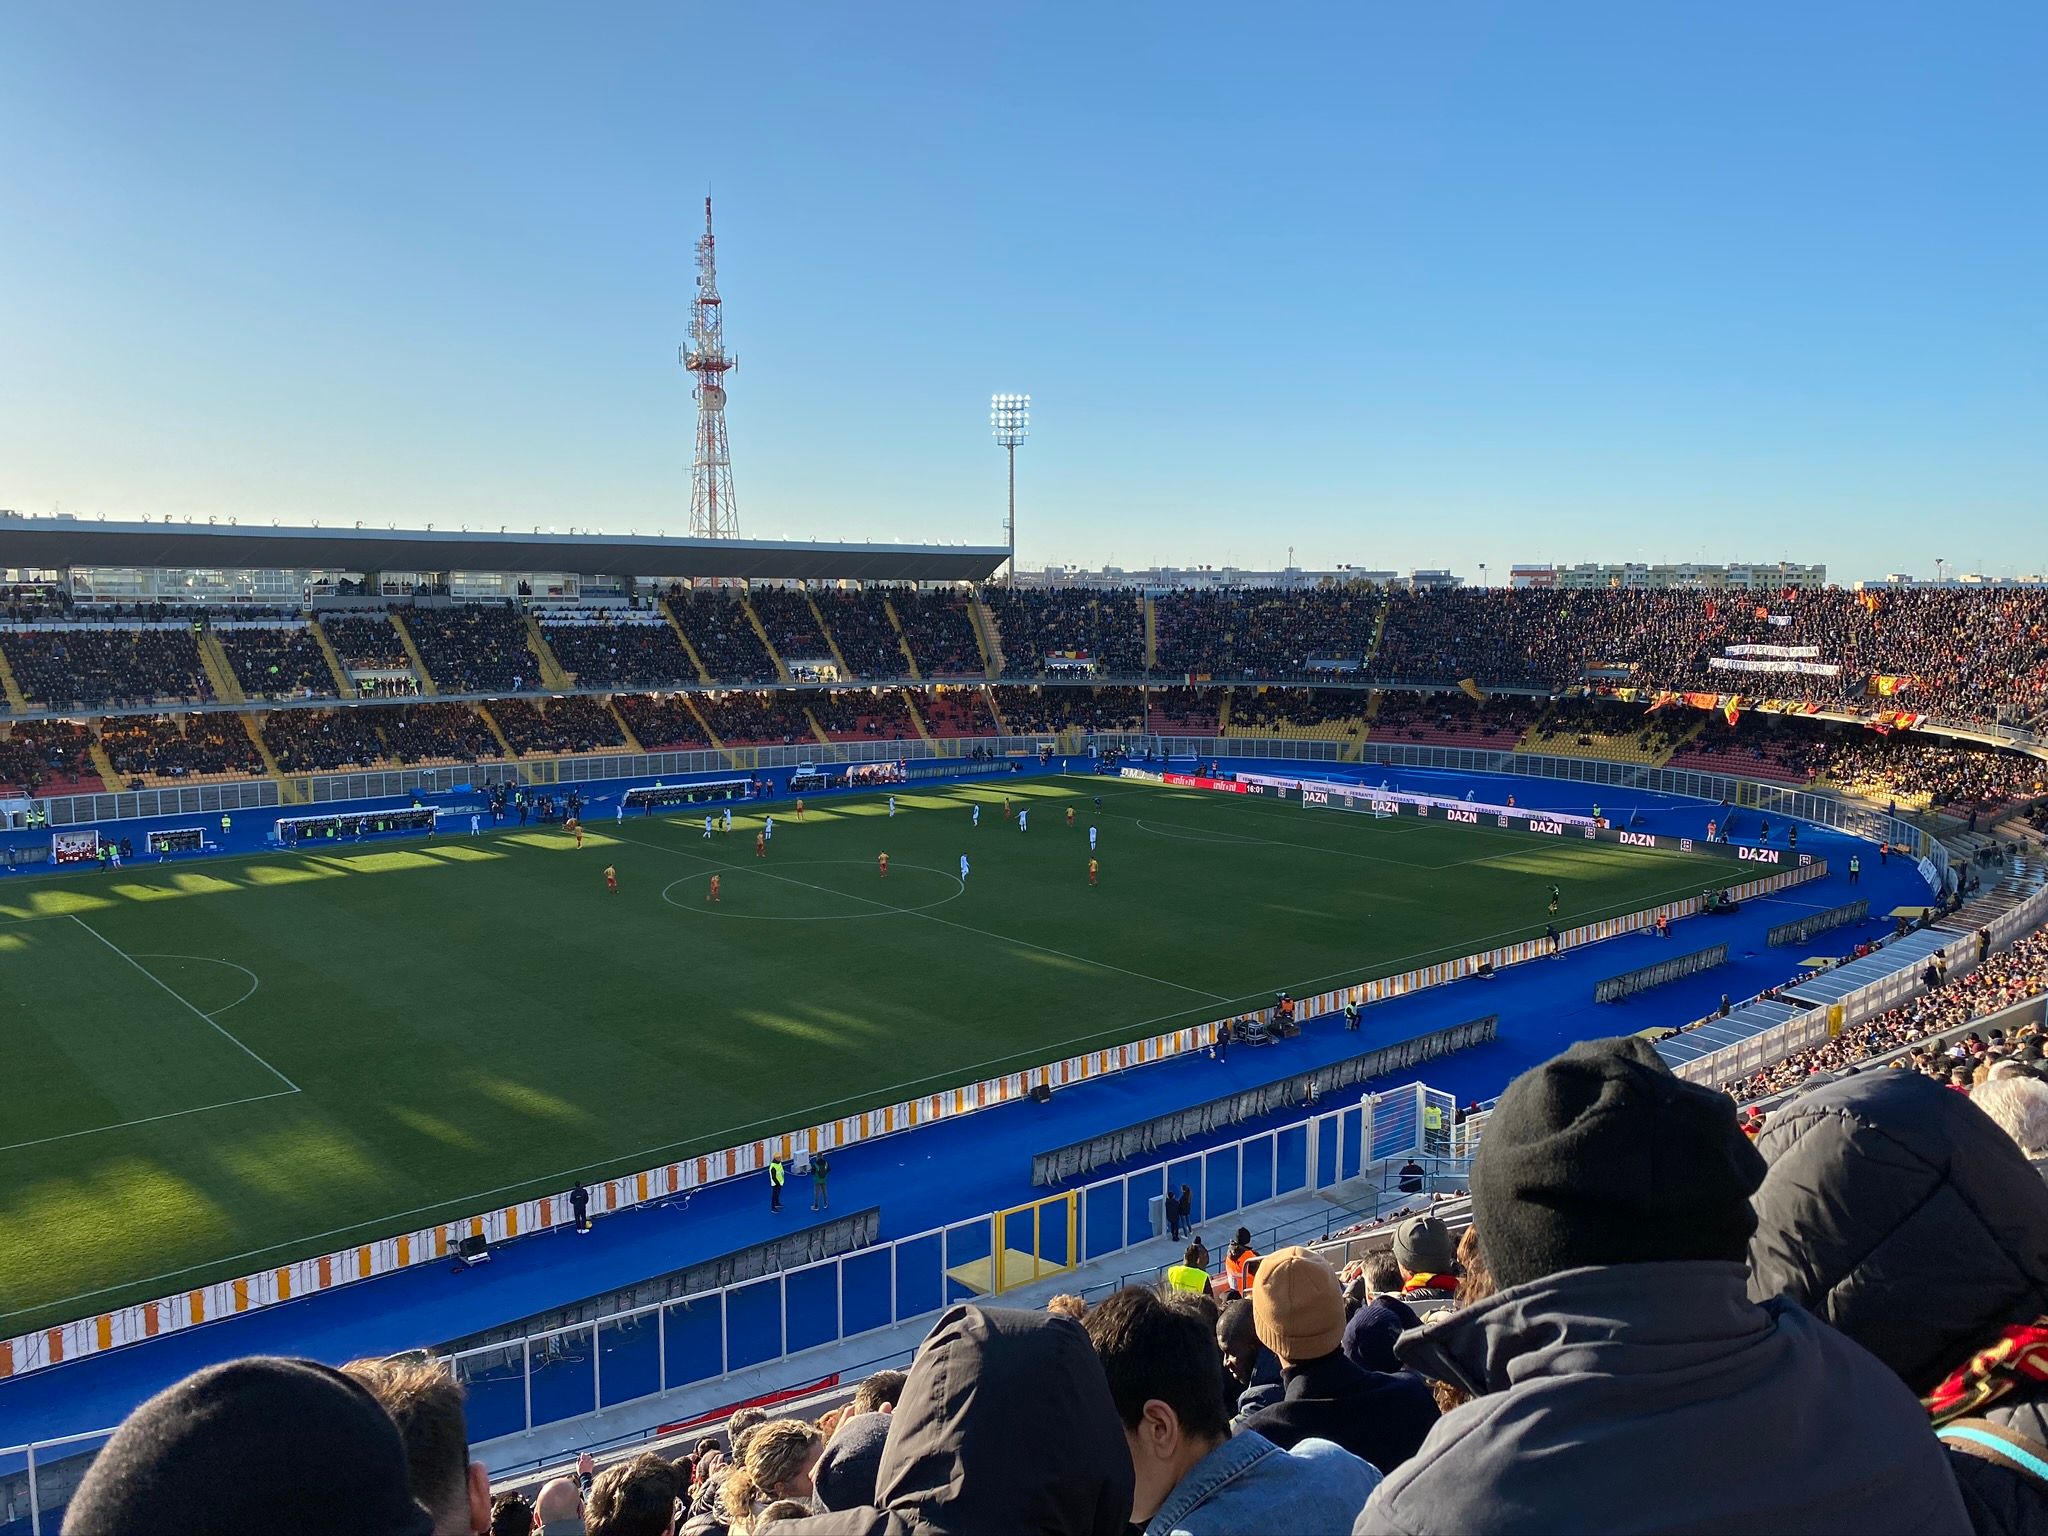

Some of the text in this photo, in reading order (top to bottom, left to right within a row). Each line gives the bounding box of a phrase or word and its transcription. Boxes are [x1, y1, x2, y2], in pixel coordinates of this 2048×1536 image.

[1304, 791, 1328, 804] DAZN
[1371, 800, 1399, 813] DAZN
[1447, 809, 1478, 824] DAZN
[1529, 820, 1563, 835] DAZN
[1619, 831, 1656, 848] DAZN
[1738, 846, 1779, 864] DAZN
